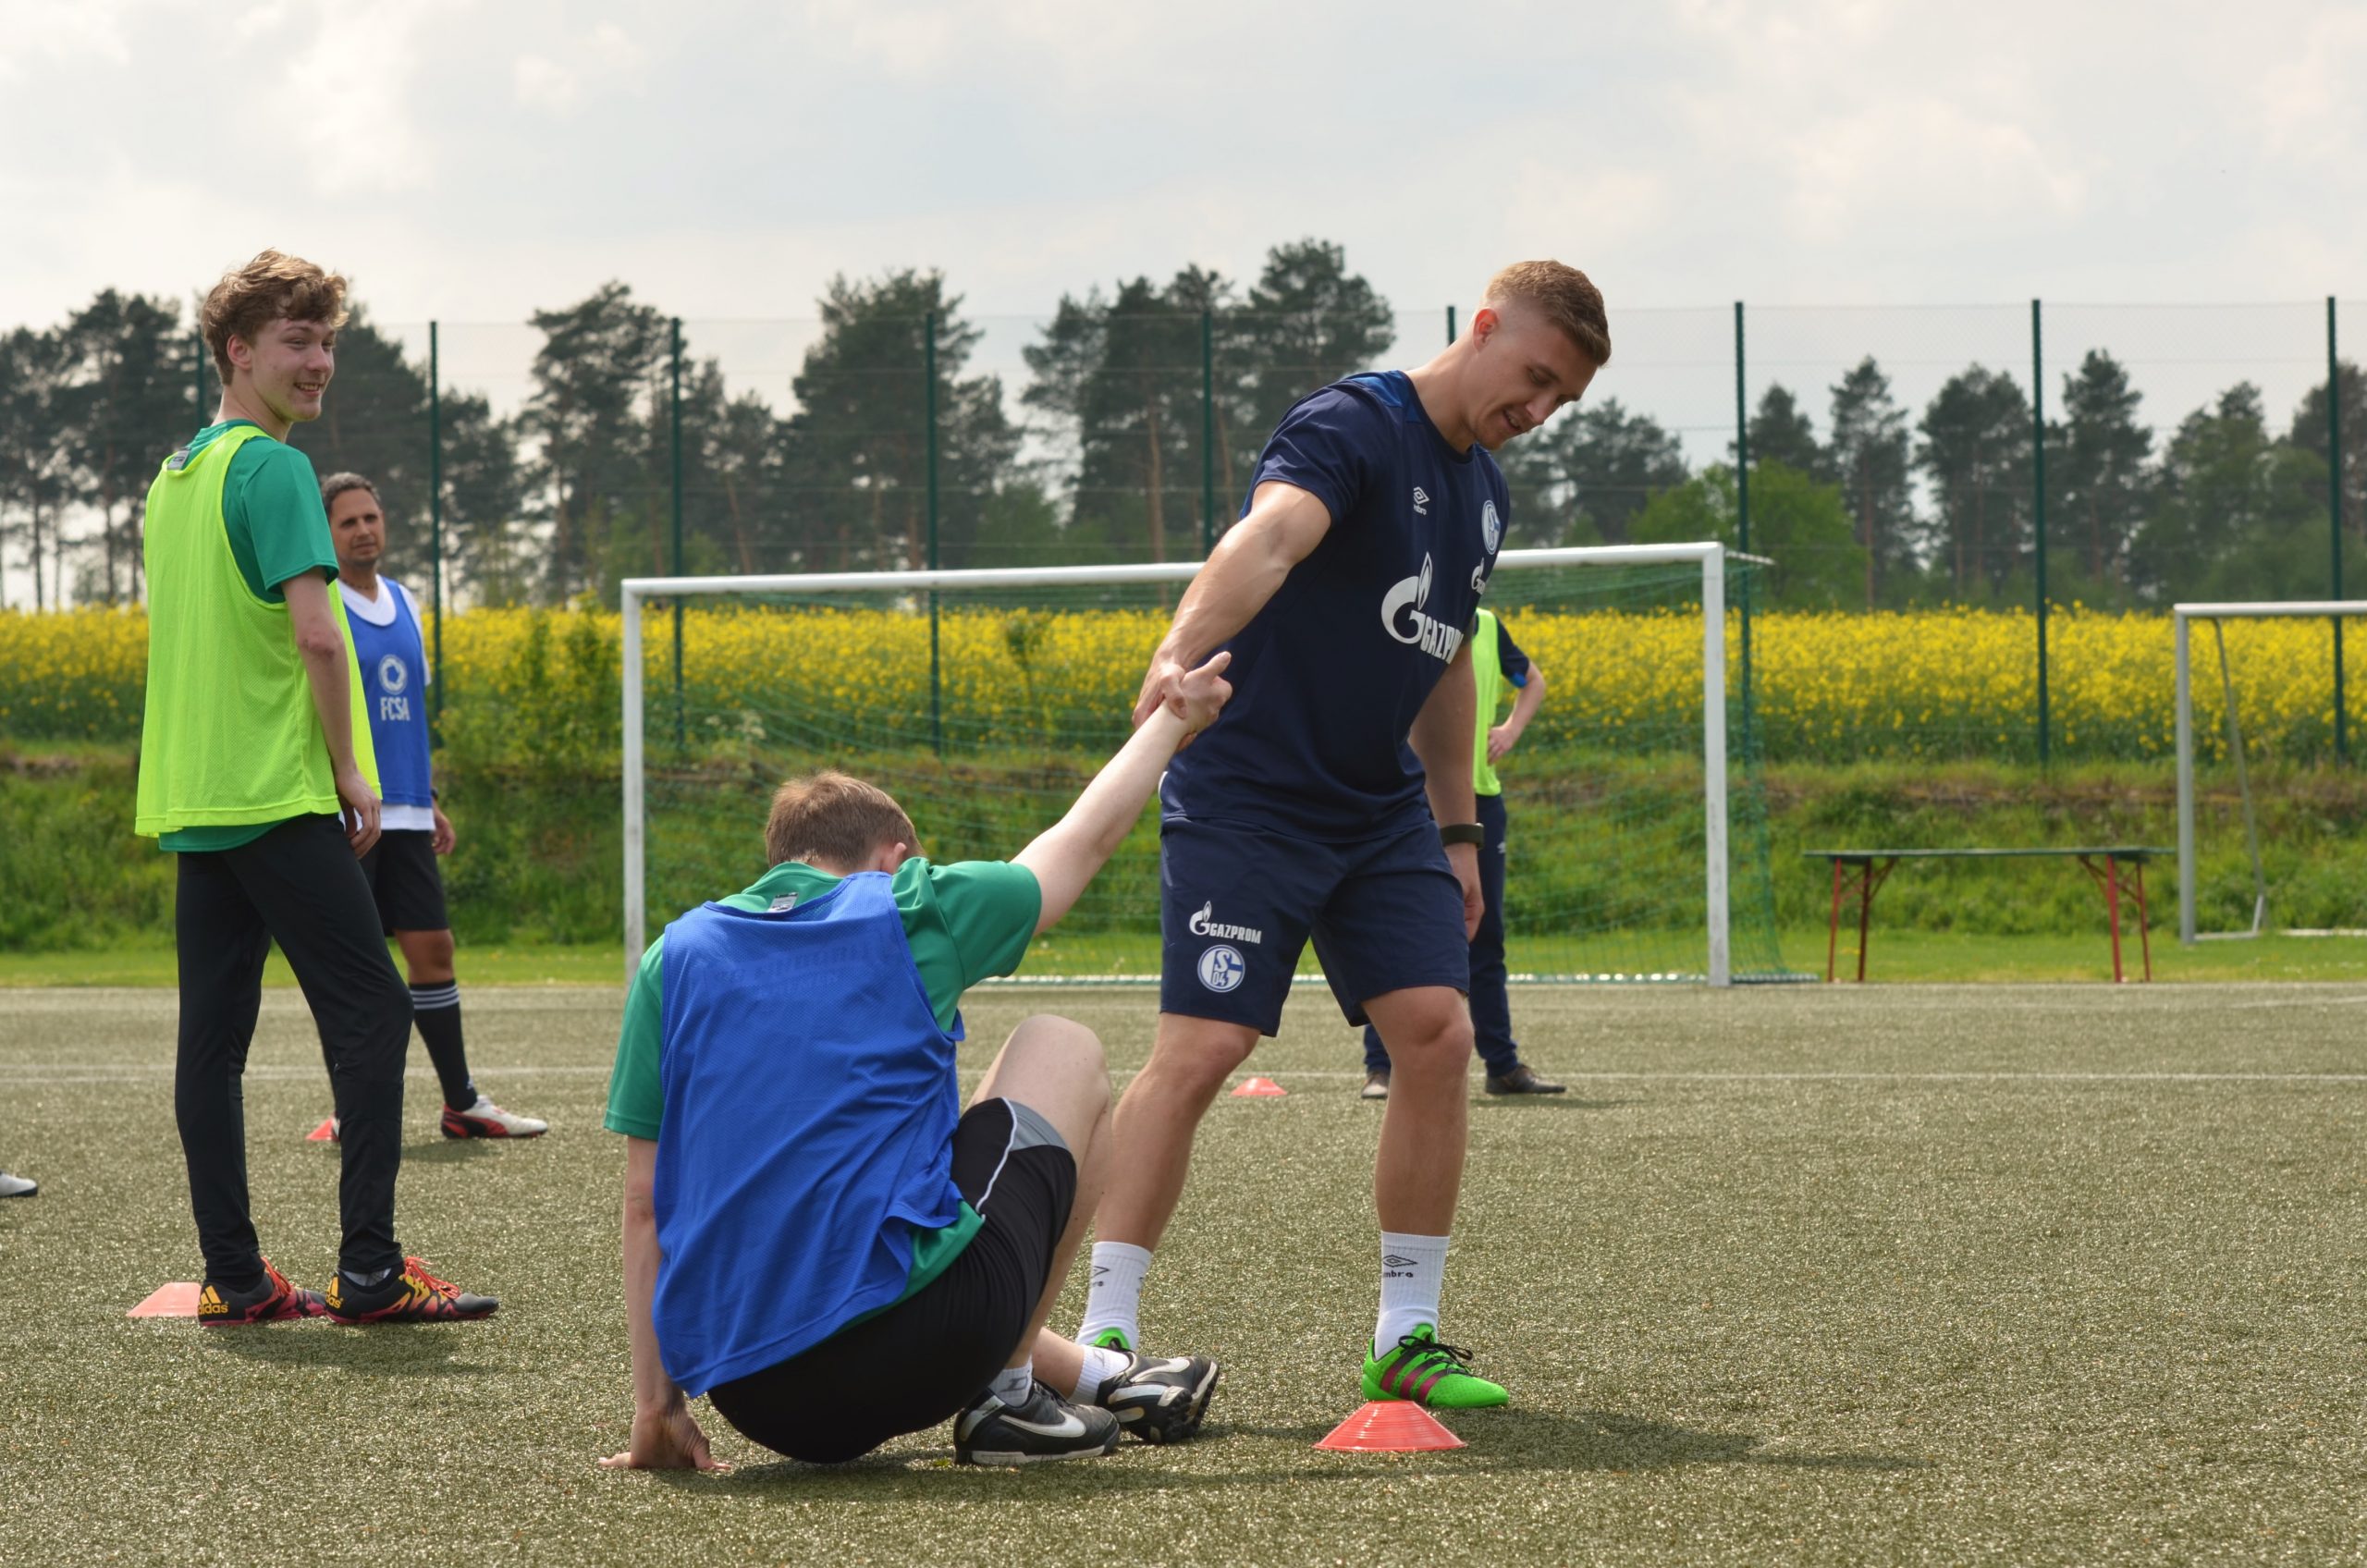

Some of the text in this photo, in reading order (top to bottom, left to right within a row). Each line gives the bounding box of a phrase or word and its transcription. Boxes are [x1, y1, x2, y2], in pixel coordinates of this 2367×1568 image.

[1420, 616, 1465, 665] GAZPR
[380, 696, 411, 721] FCSA
[1383, 1269, 1414, 1279] mbro
